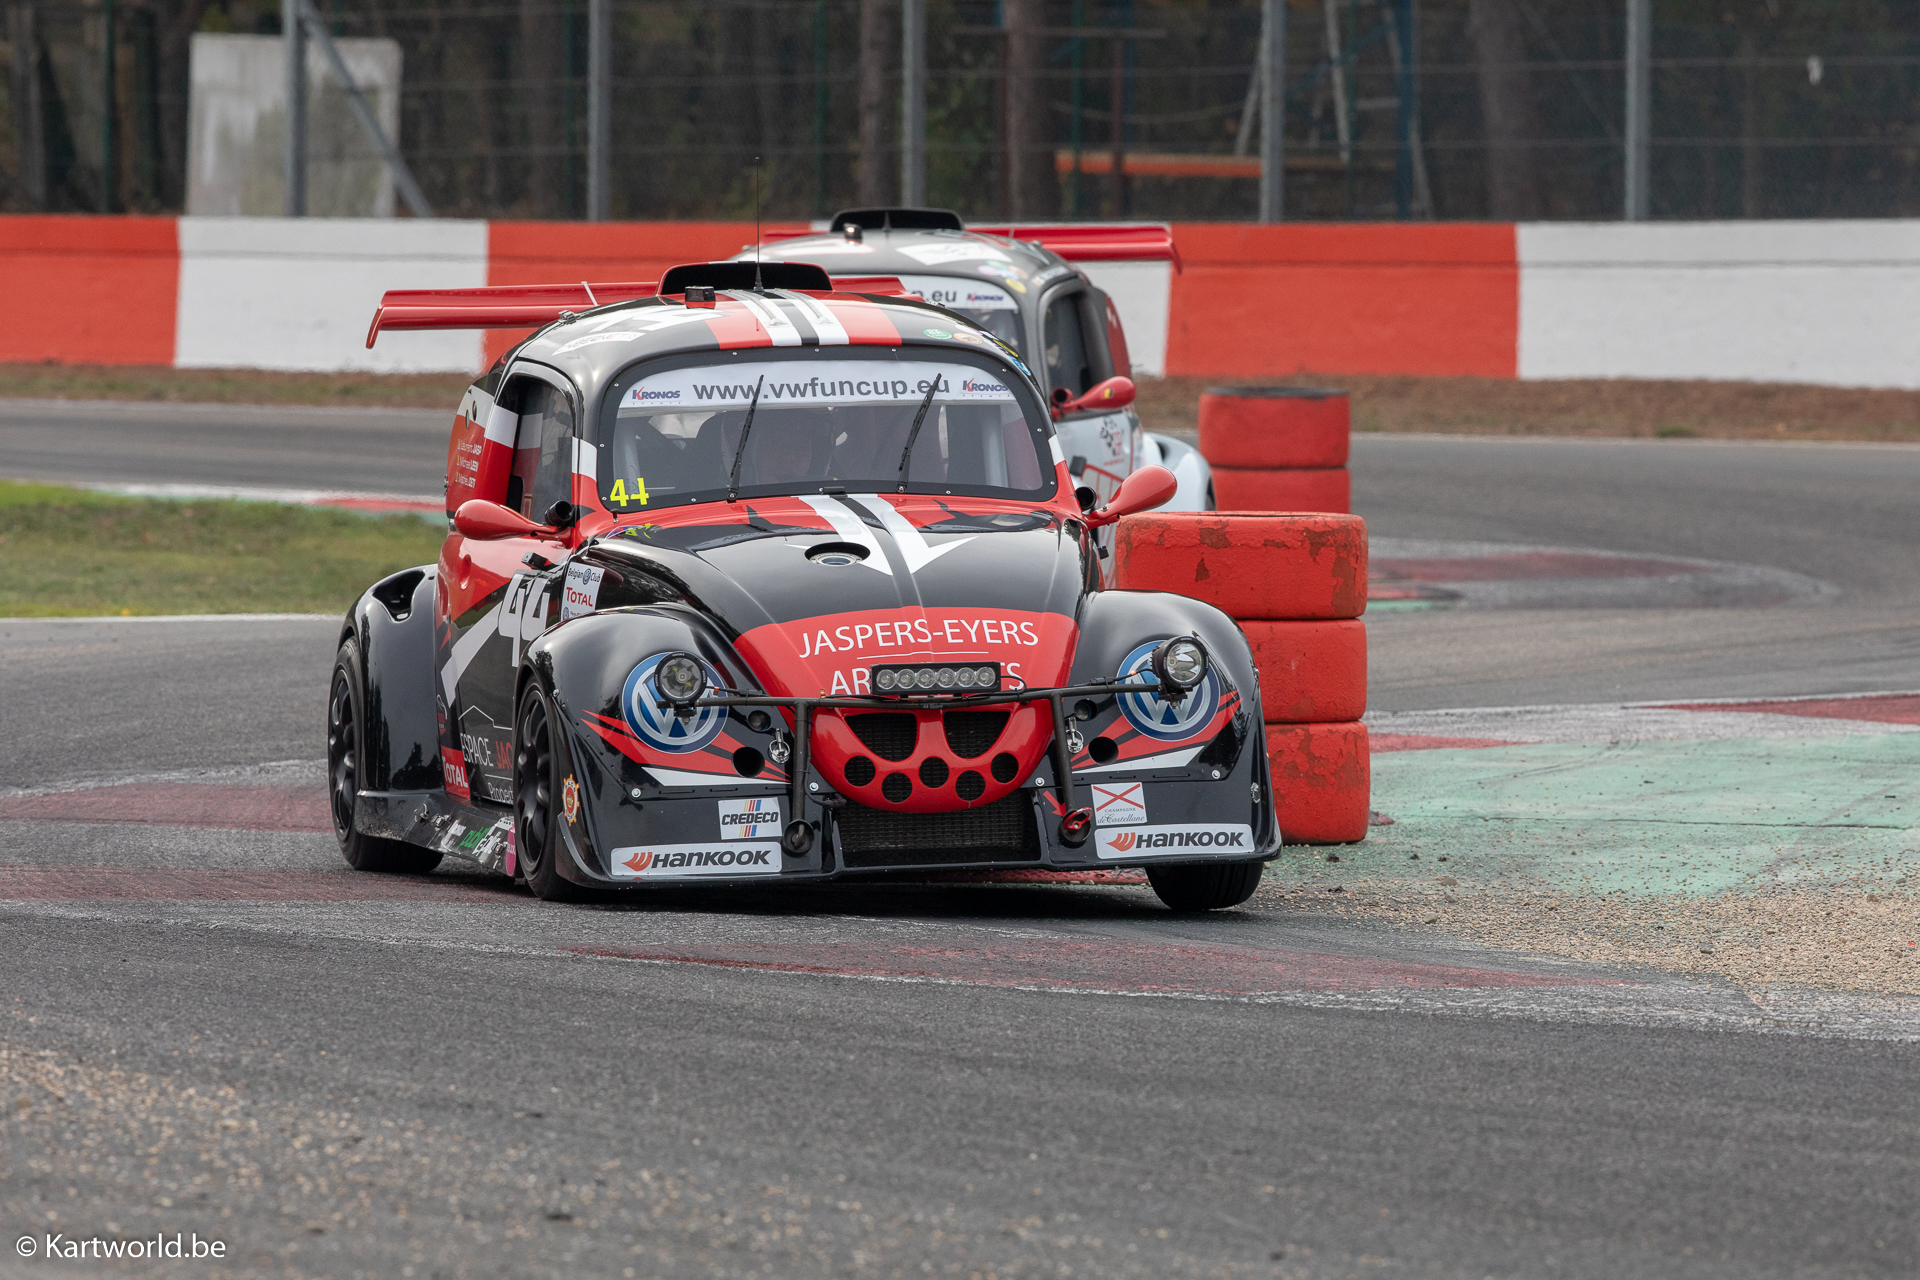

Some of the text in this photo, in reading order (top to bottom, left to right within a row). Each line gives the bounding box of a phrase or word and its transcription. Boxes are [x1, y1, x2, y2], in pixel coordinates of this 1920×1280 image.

[632, 386, 681, 400] KRONOS
[692, 376, 950, 400] www.vwfuncup.eu
[963, 377, 1009, 392] KRONOS
[610, 477, 649, 507] 44
[568, 567, 583, 580] Belgian
[591, 573, 601, 583] Club
[566, 586, 593, 607] TOTAL
[498, 573, 550, 667] 44
[799, 618, 1039, 658] JASPERS-EYERS
[461, 733, 494, 767] ESPACE
[442, 755, 469, 788] TOTAL
[722, 811, 779, 825] CREDECO
